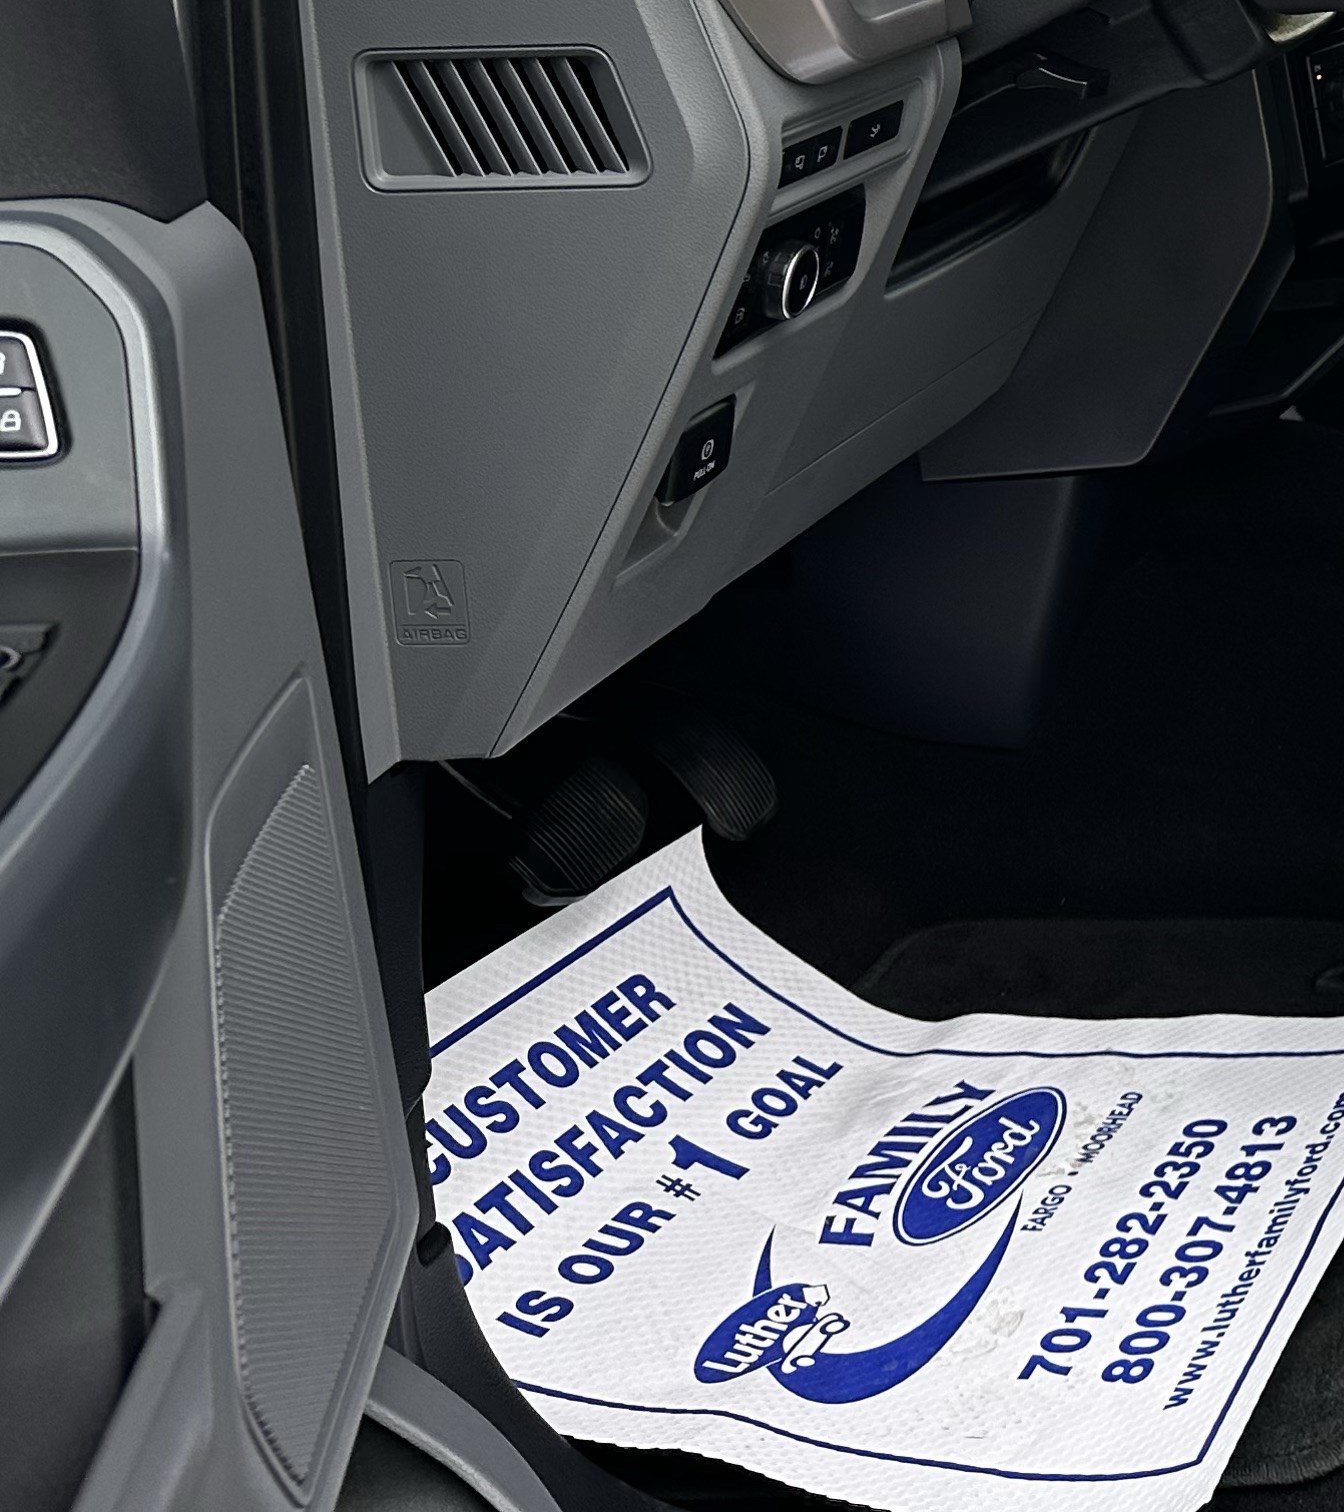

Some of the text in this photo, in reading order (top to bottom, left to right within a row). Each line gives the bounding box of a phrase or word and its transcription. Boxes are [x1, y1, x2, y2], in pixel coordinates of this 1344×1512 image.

[403, 628, 468, 640] AIRBAG
[455, 1002, 772, 1286] ATISFACTION
[495, 1055, 844, 1338] IS OUR #1 GOAL
[818, 1080, 997, 1247] FAMILY
[920, 1116, 1040, 1210] Ford
[1021, 1091, 1144, 1232] FARGO MOORHEAD
[701, 1291, 811, 1374] Luther
[1016, 1118, 1229, 1381] 701-282-2350
[1100, 1114, 1298, 1385] 800-307-4813
